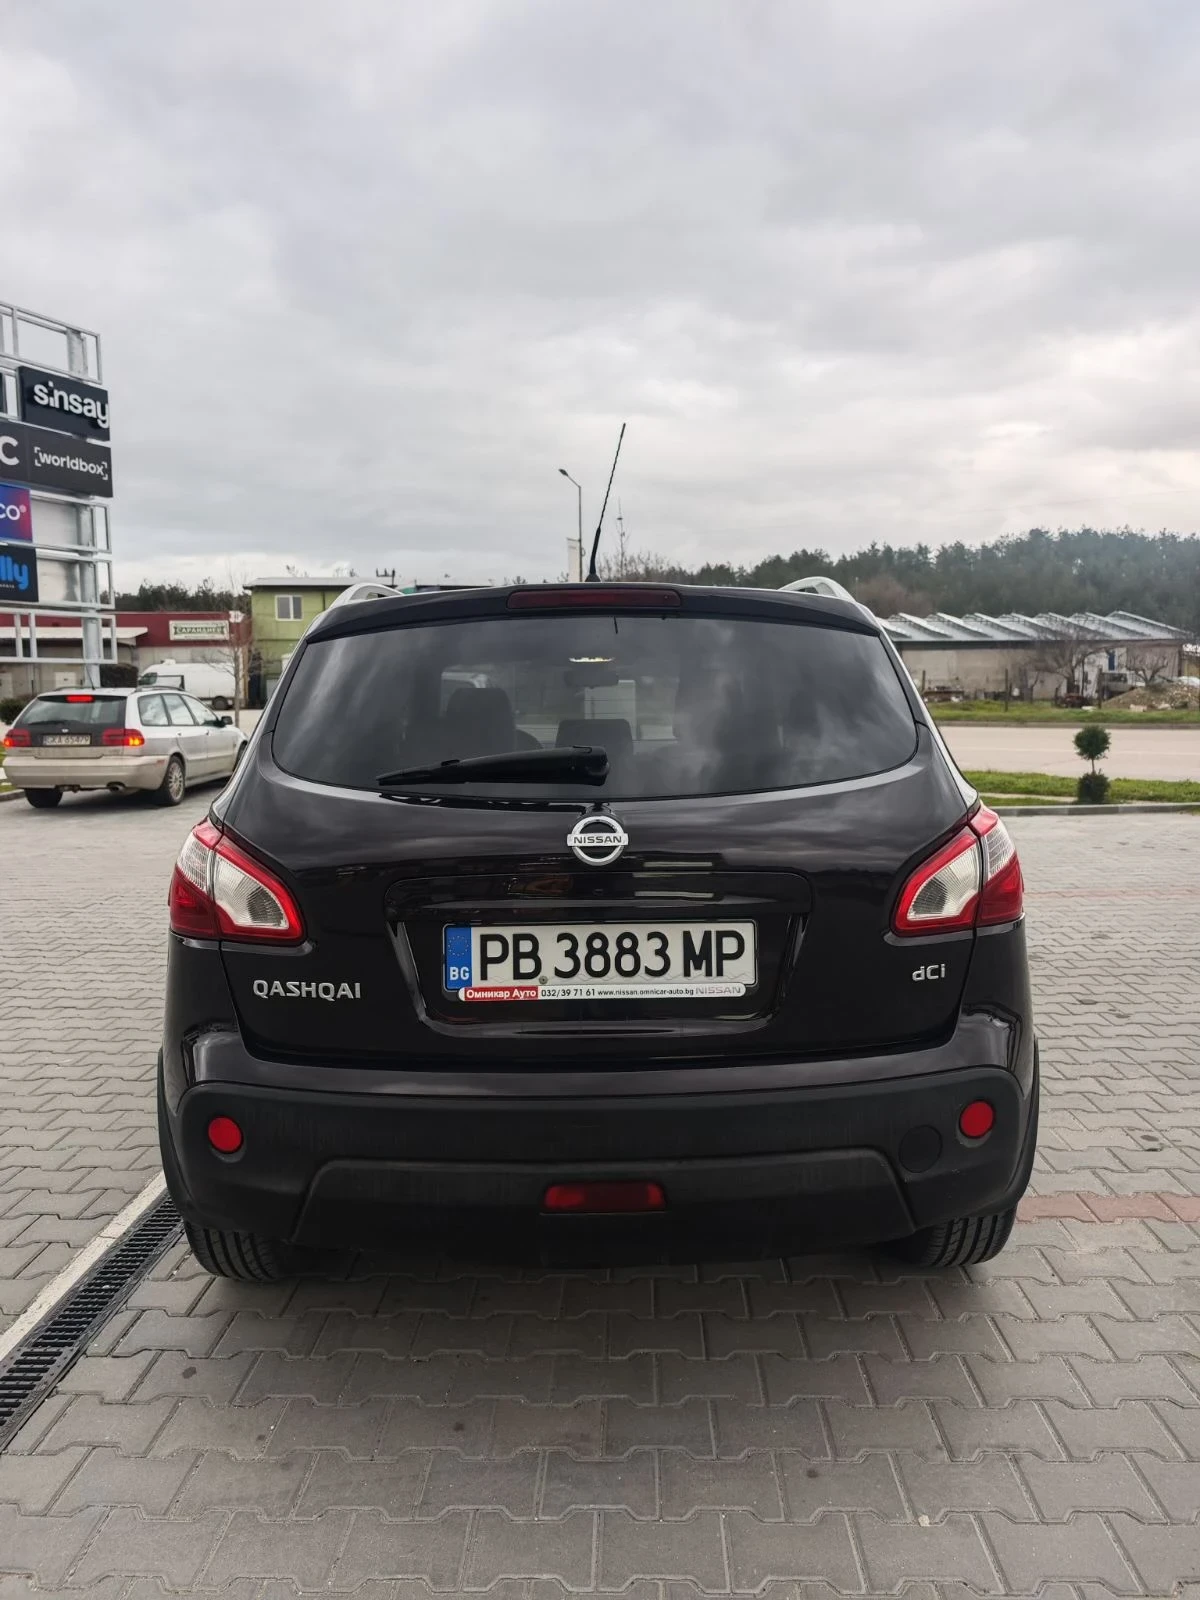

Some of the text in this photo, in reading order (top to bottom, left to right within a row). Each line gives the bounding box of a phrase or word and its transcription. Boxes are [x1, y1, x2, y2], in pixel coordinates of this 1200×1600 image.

[33, 381, 109, 428] sinsay
[573, 835, 622, 844] NISSAN
[479, 929, 746, 980] PB 3883 MP
[450, 966, 470, 981] BG
[912, 963, 946, 981] dCi
[253, 979, 361, 1001] QASHQAI
[466, 989, 537, 999] Омникар Ауто
[541, 988, 571, 997] 032/39
[574, 988, 583, 996] 71
[586, 987, 596, 996] 61
[696, 986, 741, 994] NISSAN
